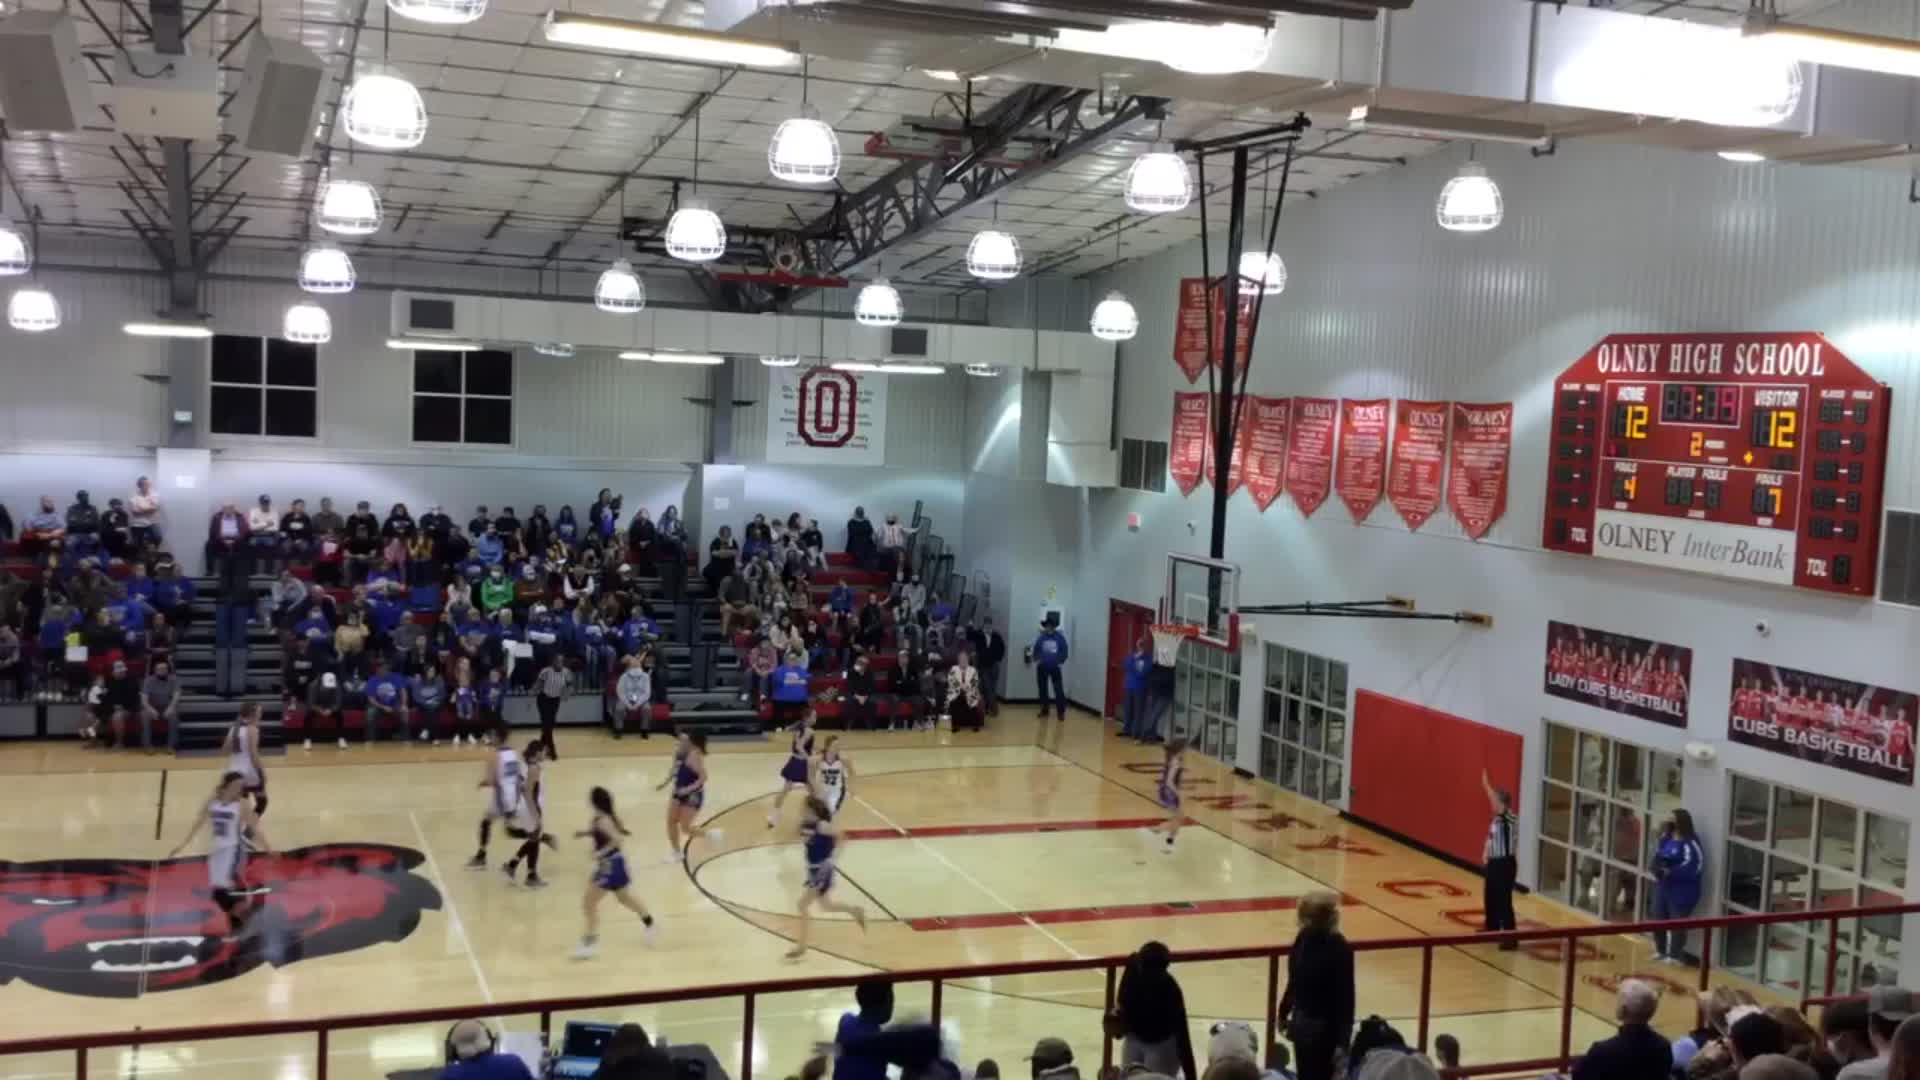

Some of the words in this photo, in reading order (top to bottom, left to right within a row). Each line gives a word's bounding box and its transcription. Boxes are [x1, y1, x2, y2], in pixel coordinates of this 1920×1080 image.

[1597, 343, 1661, 374] OLNEY
[1670, 343, 1722, 374] HIGH
[1733, 343, 1825, 376] SCHOOL
[1754, 389, 1799, 407] VISITOR
[1625, 404, 1649, 439] 12
[1769, 410, 1797, 448] 12
[1690, 431, 1704, 457] 2
[1768, 487, 1783, 515] 7
[1598, 523, 1677, 554] OLNEY
[1681, 532, 1789, 570] InterBank
[1548, 672, 1577, 689] LADY
[1577, 678, 1607, 697] CUBS
[1608, 685, 1683, 716] BASKETBALL
[1732, 715, 1780, 740] CUBS
[1784, 727, 1910, 772] BASKETBALL
